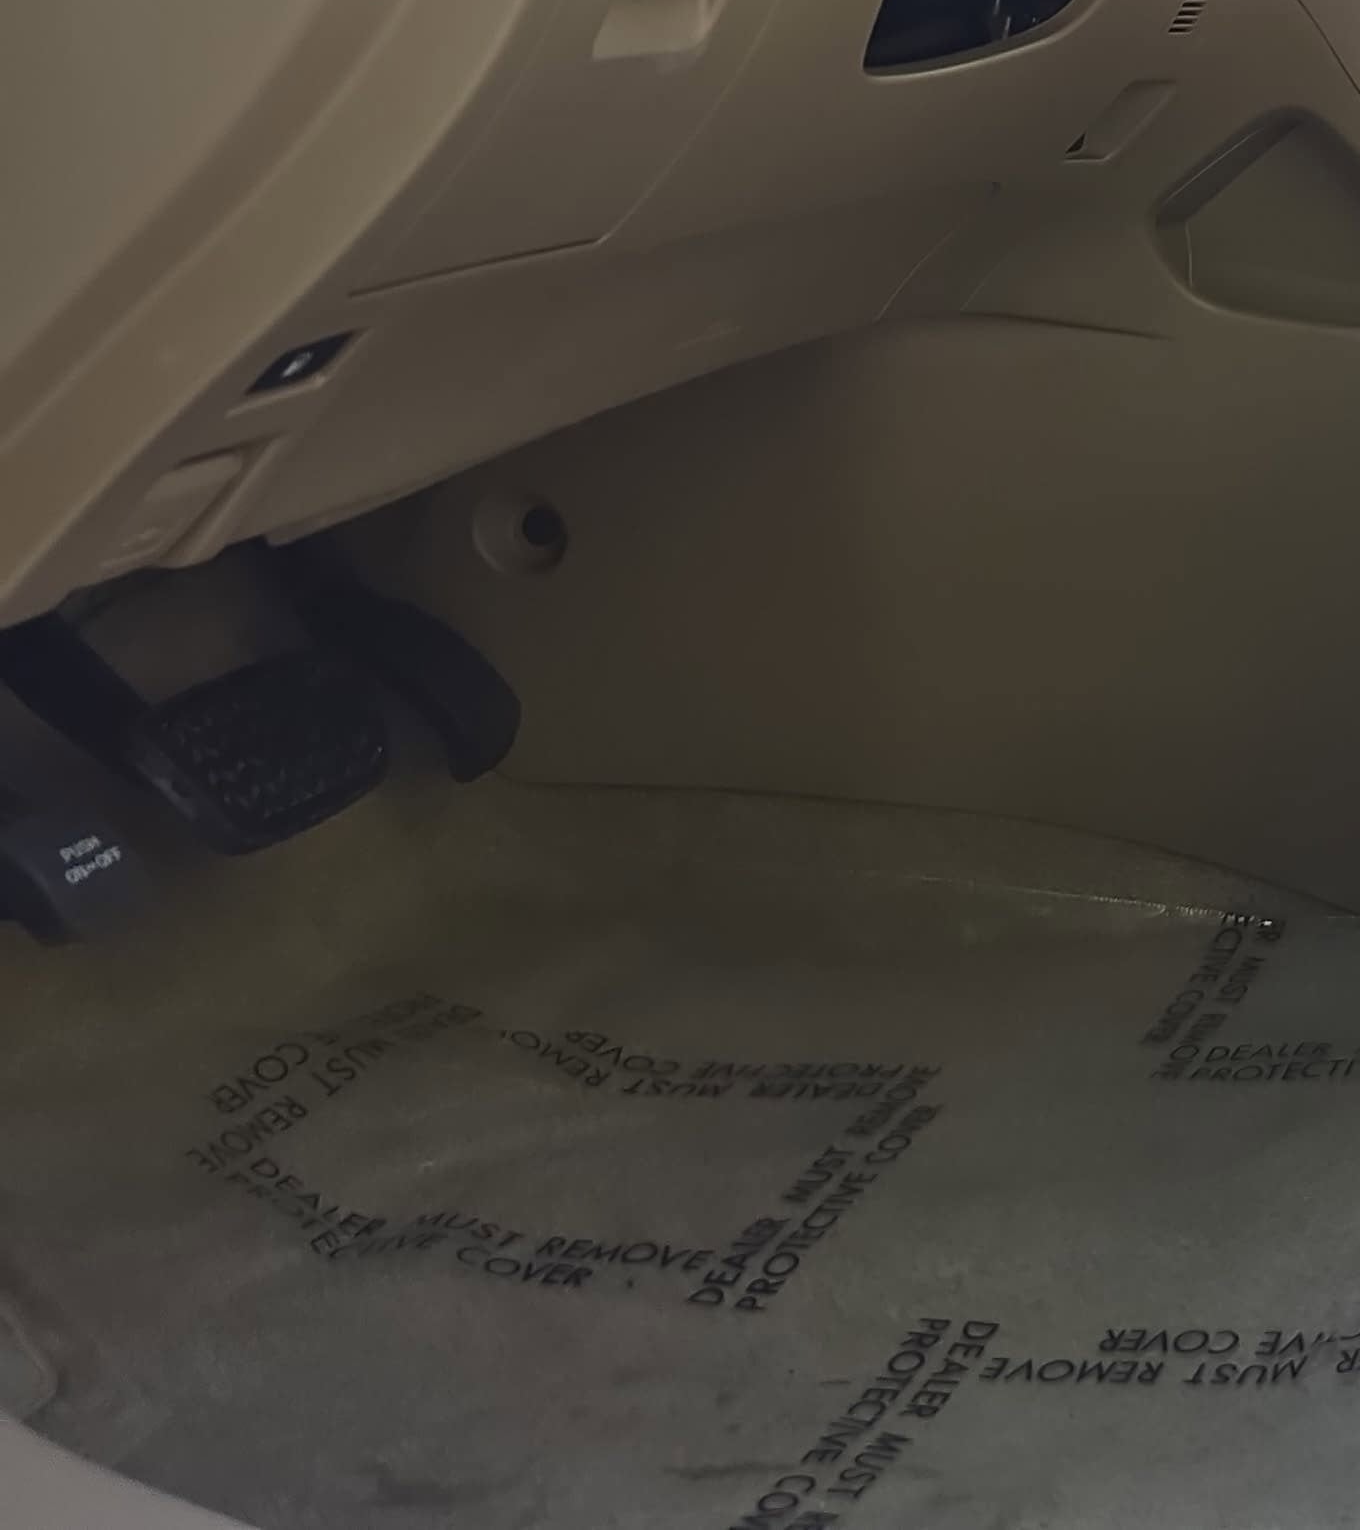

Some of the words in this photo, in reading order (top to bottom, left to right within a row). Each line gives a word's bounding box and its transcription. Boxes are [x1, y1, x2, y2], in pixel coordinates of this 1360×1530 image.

[564, 1030, 681, 1076] COVER
[1204, 1041, 1333, 1063] DEALER
[536, 1235, 715, 1271] REMOVE
[686, 1217, 792, 1305] DEALER
[734, 1172, 879, 1311] PROTECTIVE
[455, 1245, 594, 1290] COVER
[1098, 1328, 1241, 1356] COVER
[801, 1317, 951, 1464] PROTECTIVE
[898, 1320, 1001, 1419] DEALER
[979, 1357, 1165, 1384] REMOVE
[1183, 1355, 1309, 1385] MUST
[827, 1431, 914, 1499] MUST
